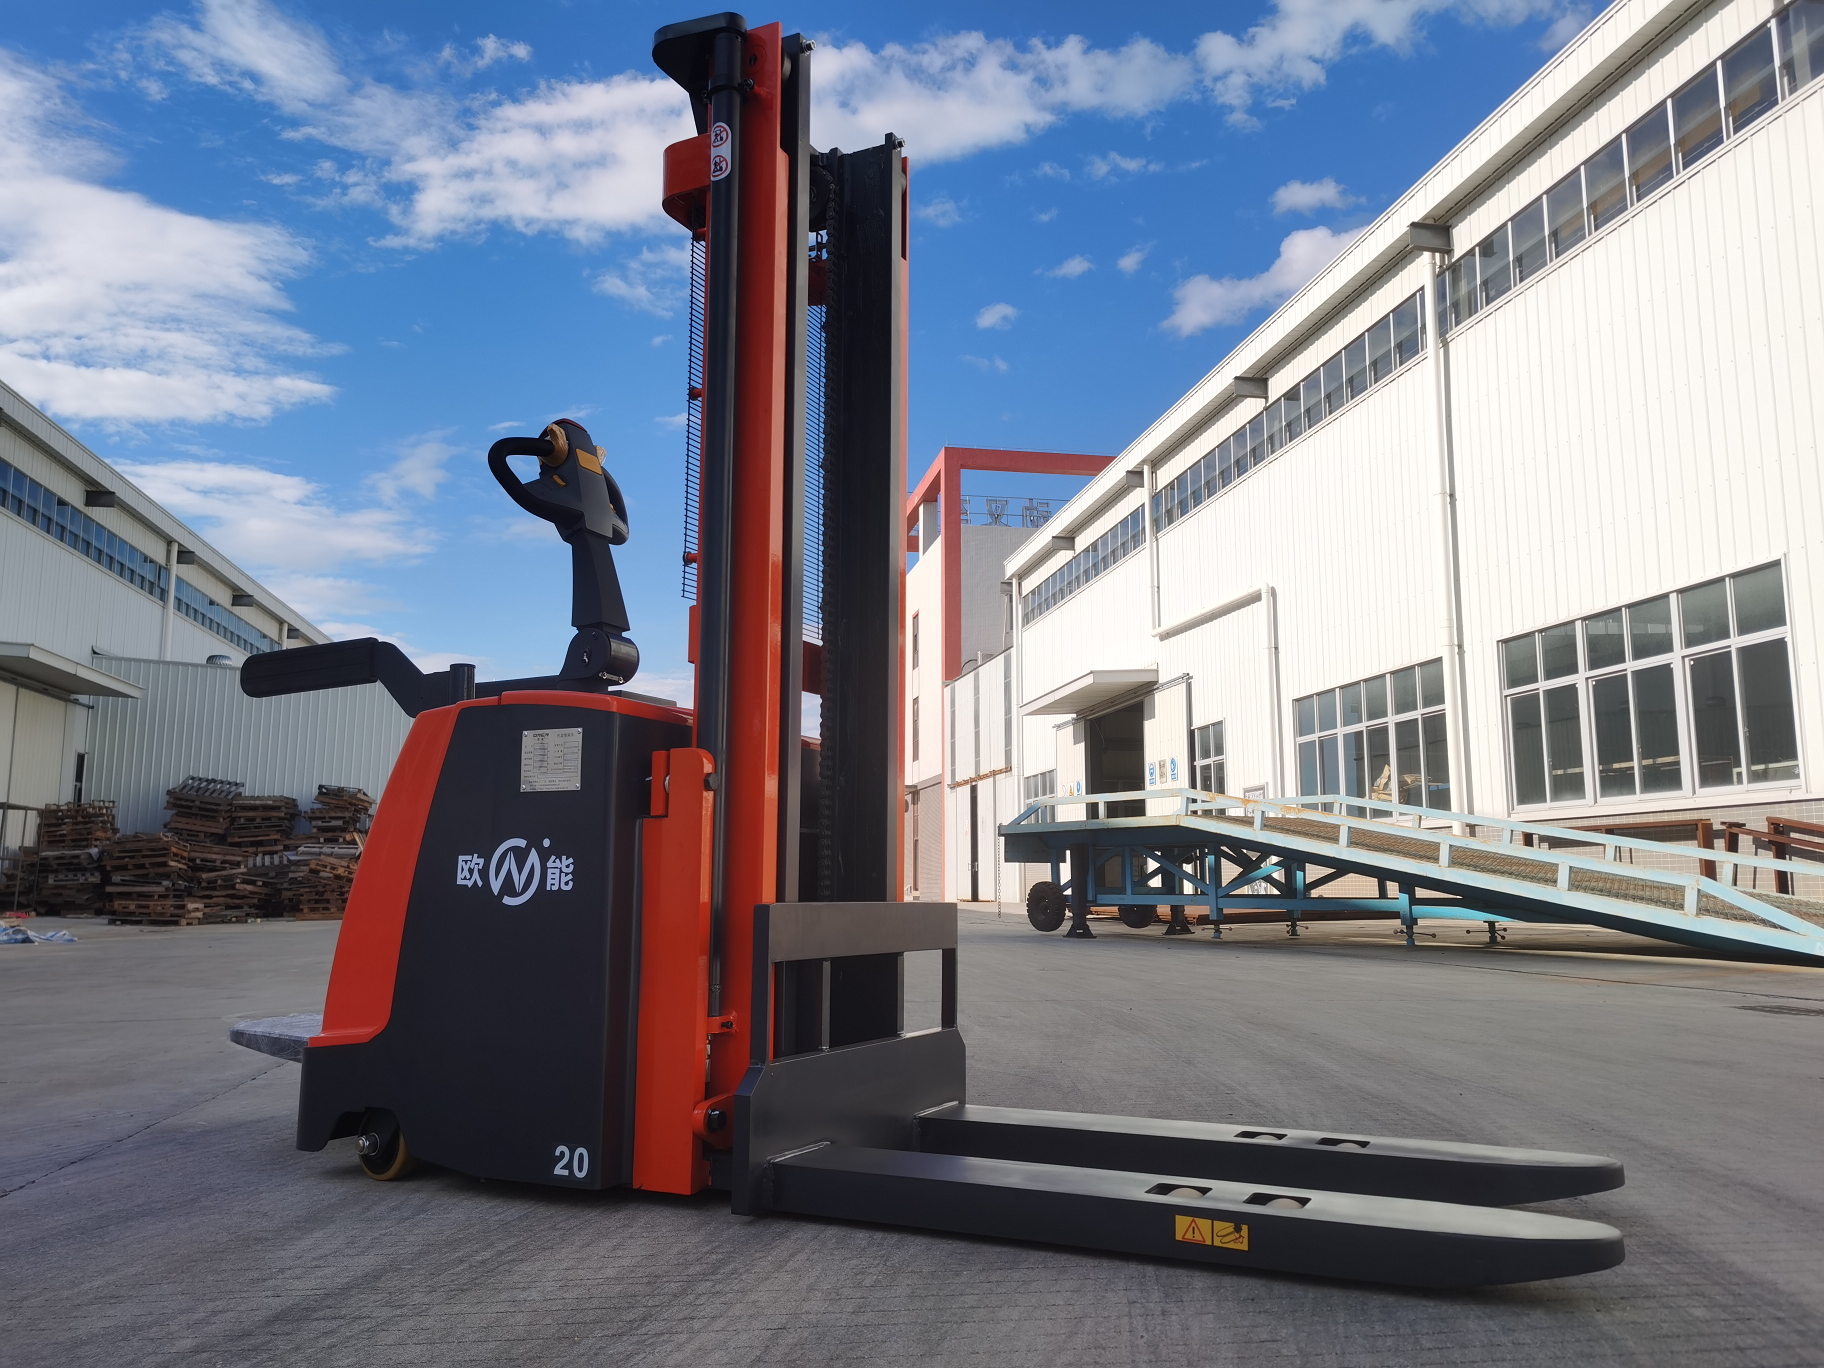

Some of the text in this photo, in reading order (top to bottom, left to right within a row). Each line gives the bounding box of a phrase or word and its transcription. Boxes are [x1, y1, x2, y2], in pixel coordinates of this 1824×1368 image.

[456, 853, 575, 891] 欧 能
[553, 1145, 589, 1179] 20
